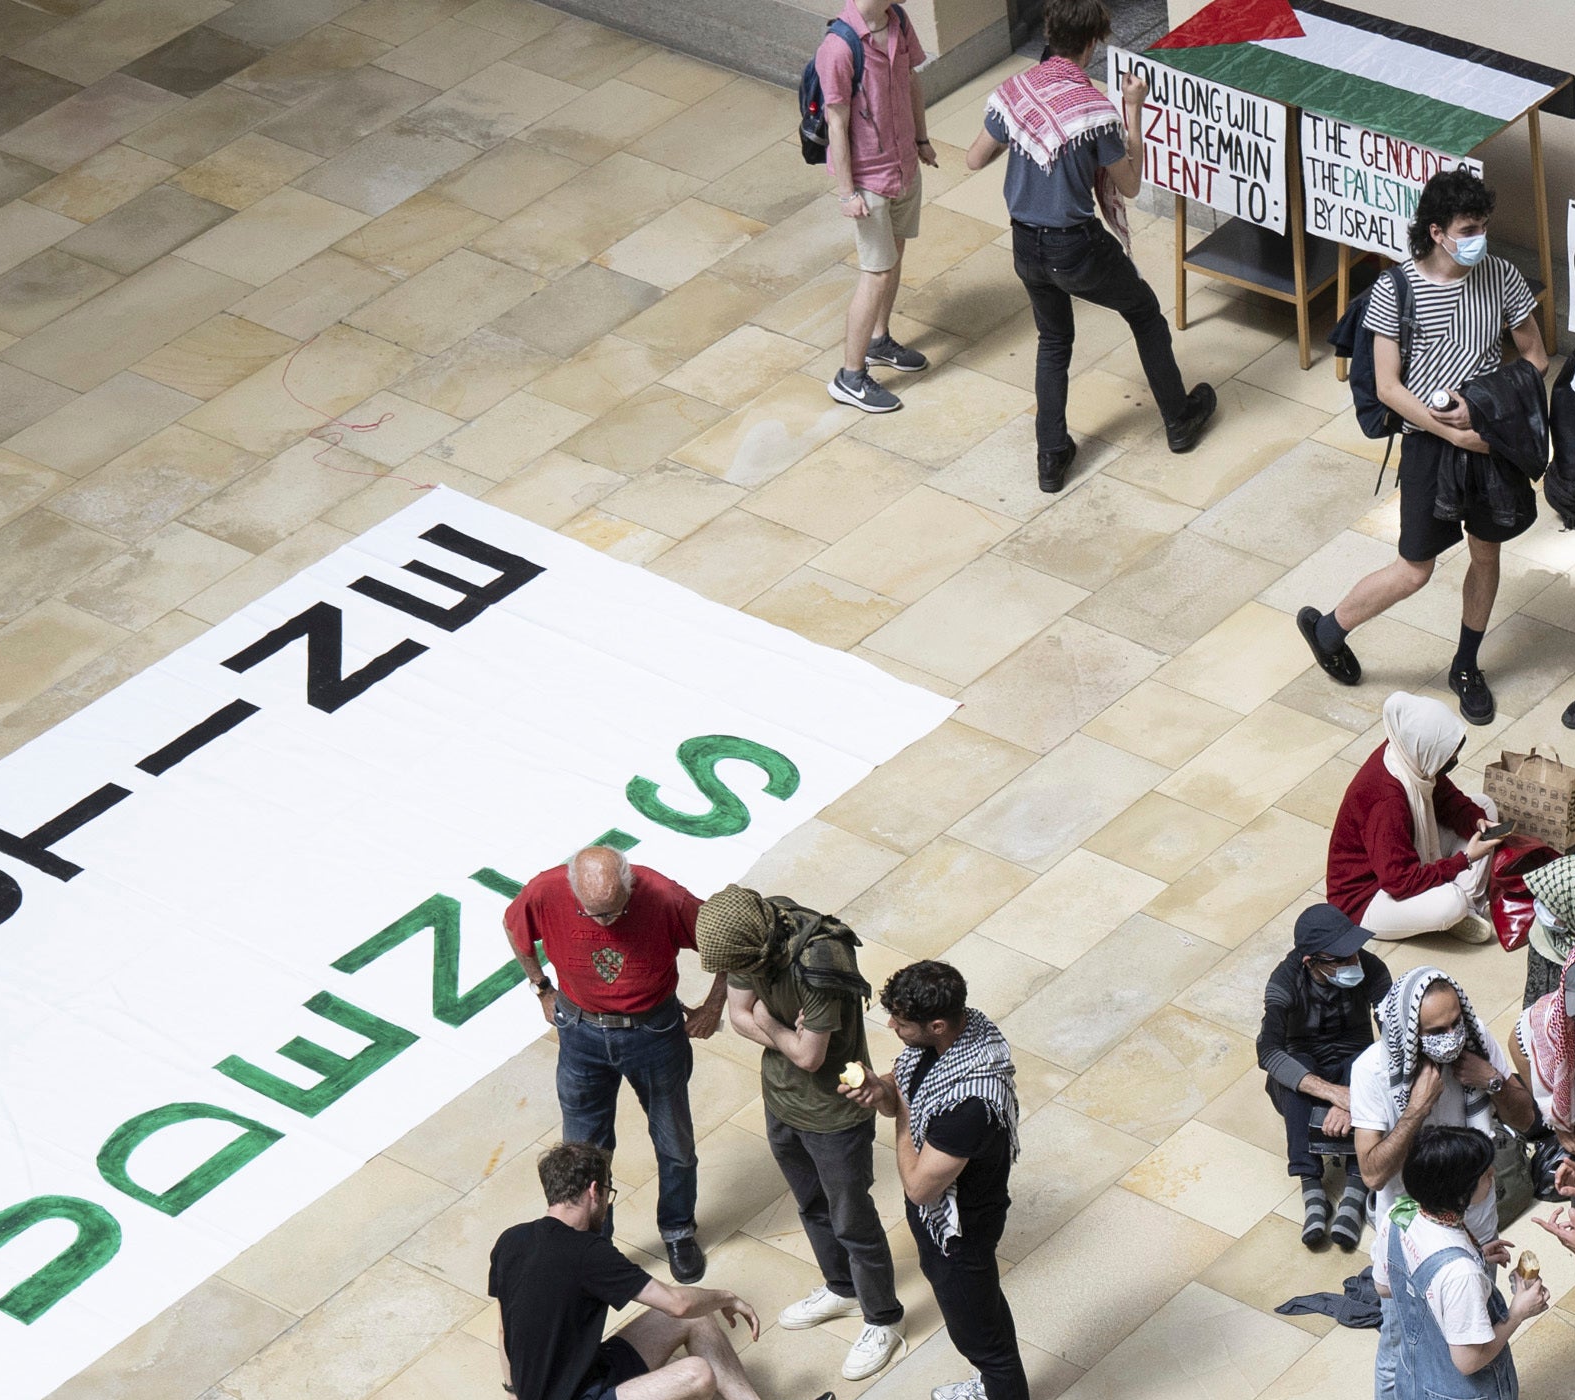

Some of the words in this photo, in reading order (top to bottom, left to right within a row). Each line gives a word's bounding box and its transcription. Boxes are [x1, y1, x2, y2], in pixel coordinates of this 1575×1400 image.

[1173, 75, 1223, 122] LONG
[1227, 97, 1276, 143] WILL
[1304, 112, 1351, 159] THE
[1143, 142, 1220, 204] ILENT
[1230, 174, 1280, 224] TO:
[1190, 120, 1271, 183] REMAIN
[1306, 156, 1344, 197] THE
[1343, 166, 1423, 219] PALESTIN
[1314, 197, 1336, 236] BY
[1340, 205, 1403, 253] ISRAEL
